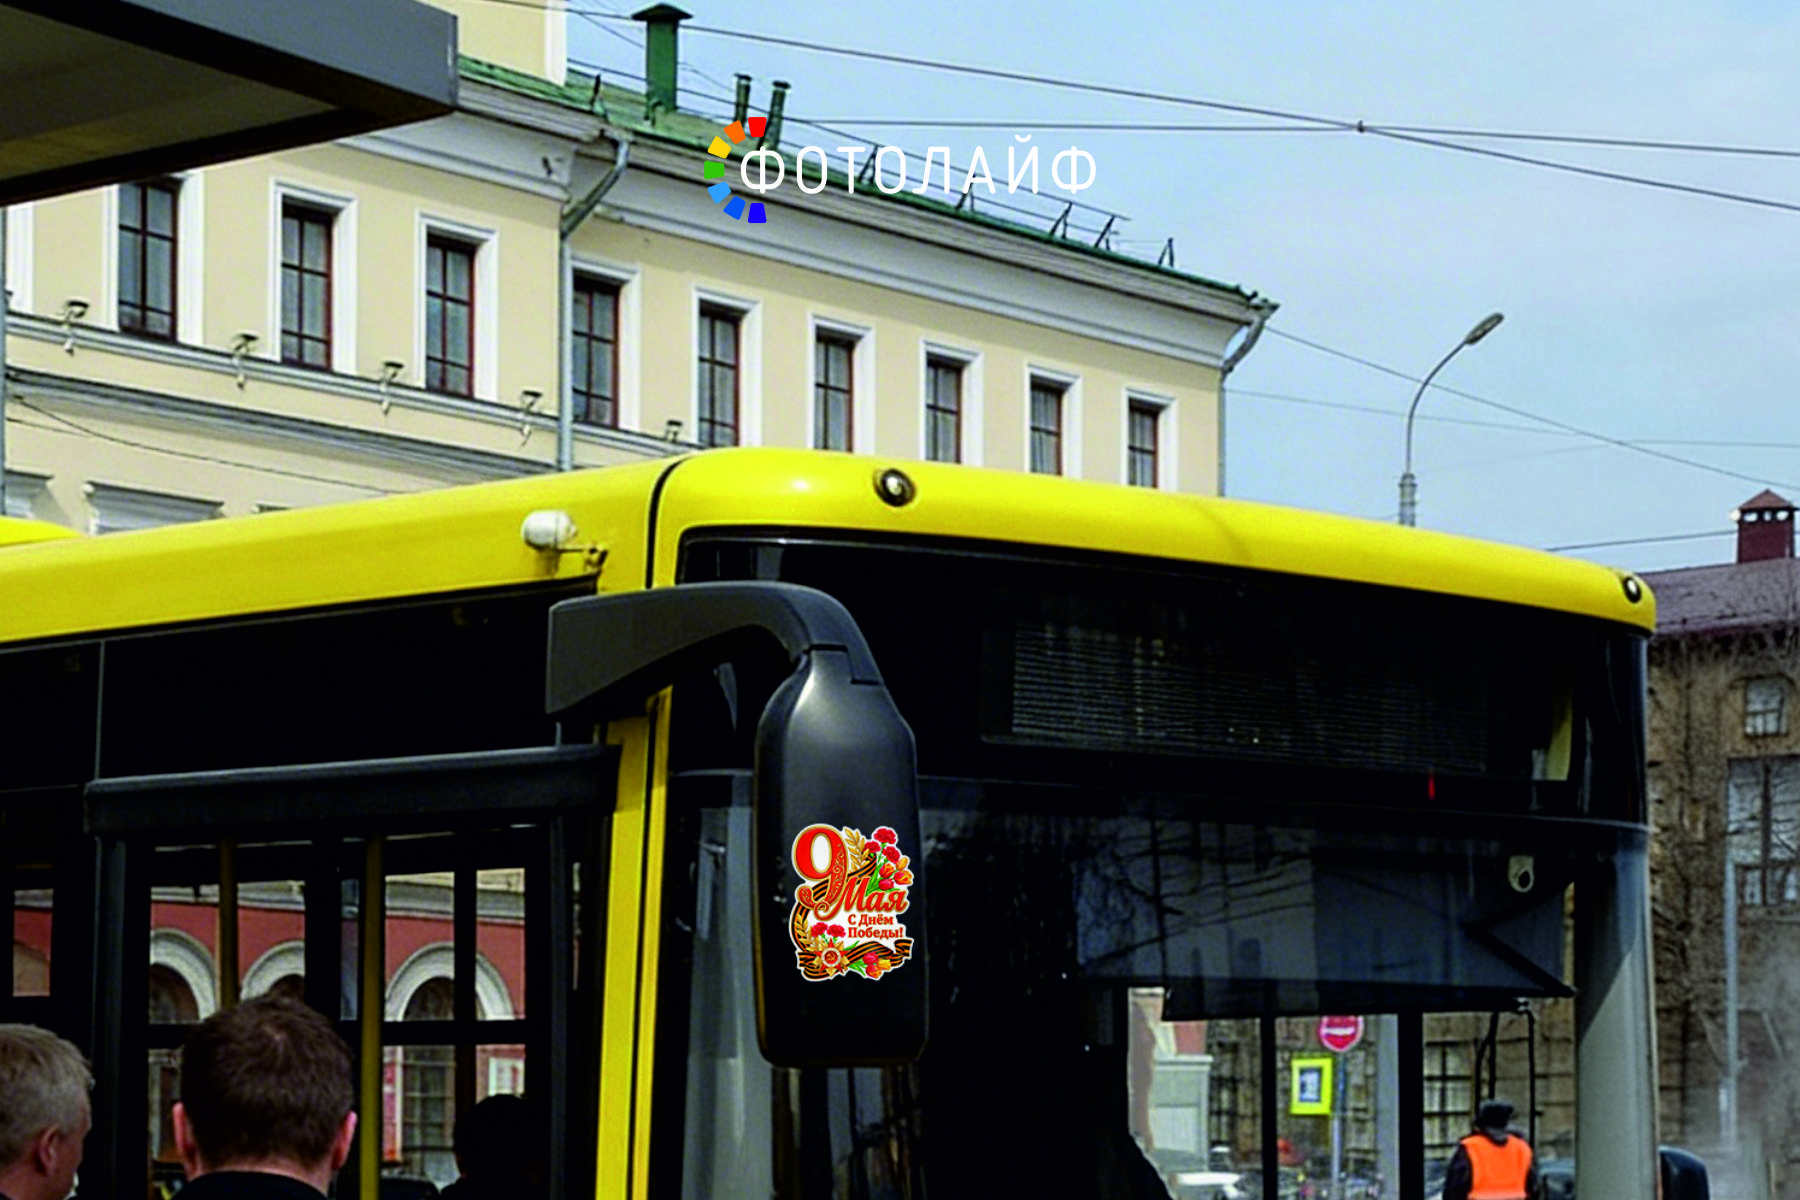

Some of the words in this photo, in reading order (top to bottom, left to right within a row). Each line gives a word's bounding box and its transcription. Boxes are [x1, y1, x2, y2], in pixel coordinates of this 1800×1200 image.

[793, 825, 849, 910] 9
[814, 877, 909, 920] Мая
[848, 914, 857, 926] С
[859, 914, 894, 926] Днём
[848, 927, 903, 939] Победы!
